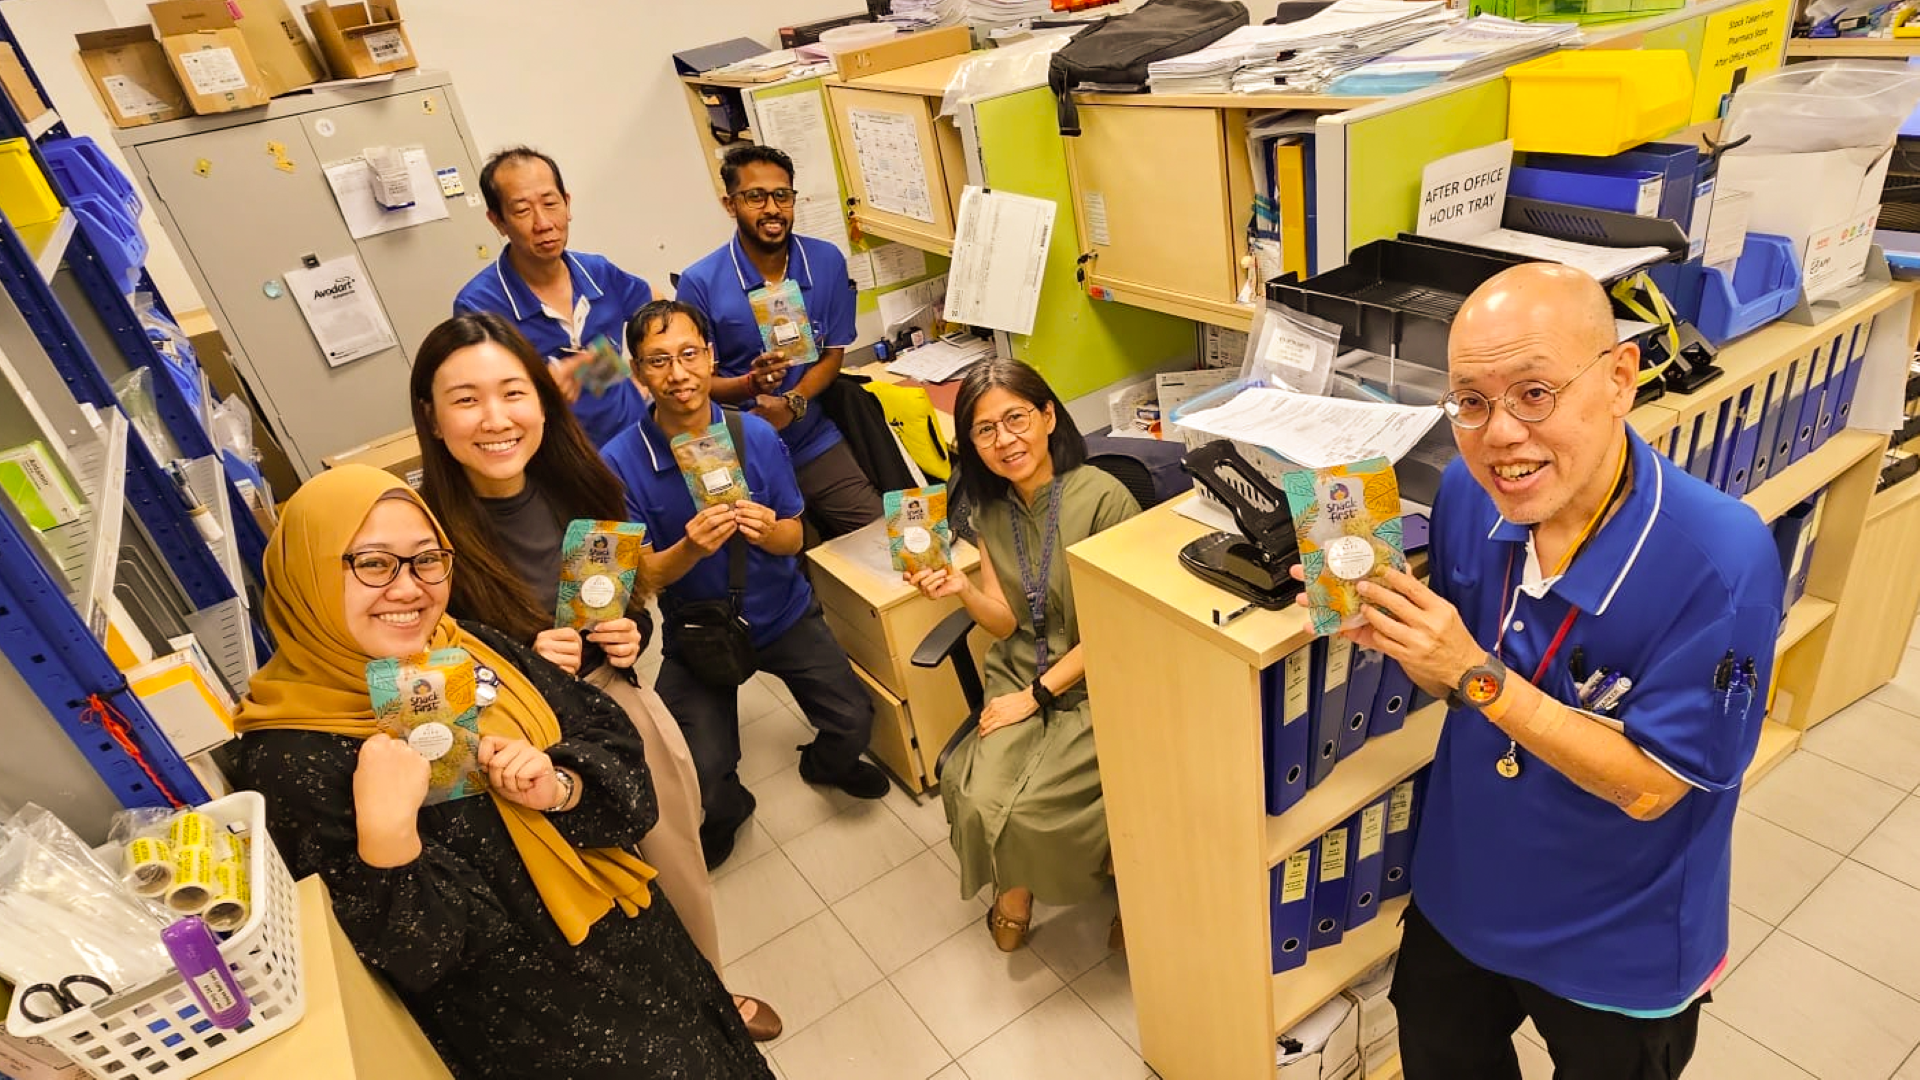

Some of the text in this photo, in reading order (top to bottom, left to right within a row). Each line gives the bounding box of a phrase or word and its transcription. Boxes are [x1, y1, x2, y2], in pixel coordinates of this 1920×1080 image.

[1728, 16, 1744, 29] Stock
[1745, 13, 1760, 24] Taken
[1754, 27, 1768, 37] Store
[1713, 57, 1729, 68] After
[1728, 51, 1745, 63] Office
[1424, 166, 1504, 207] AFTER OFFICE
[1428, 190, 1498, 228] HOUR TRAY
[313, 280, 352, 301] Avodart
